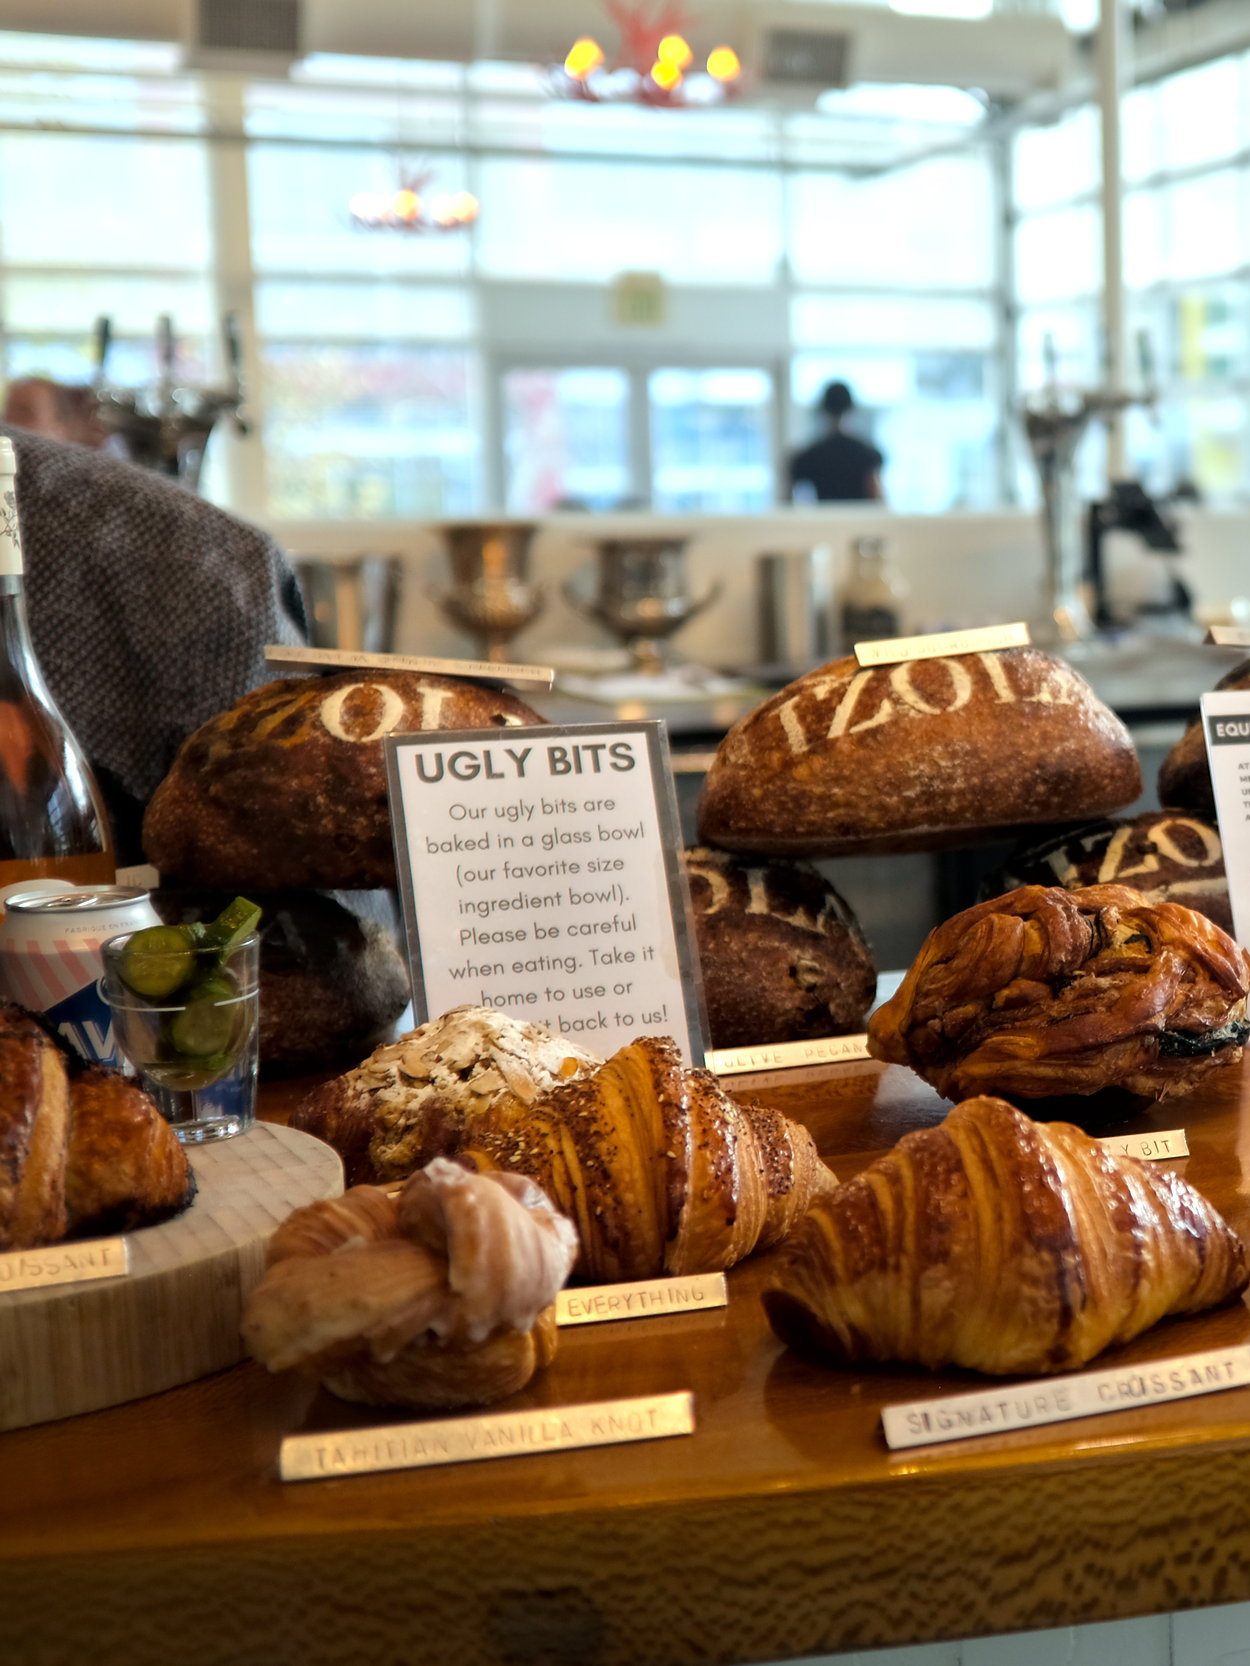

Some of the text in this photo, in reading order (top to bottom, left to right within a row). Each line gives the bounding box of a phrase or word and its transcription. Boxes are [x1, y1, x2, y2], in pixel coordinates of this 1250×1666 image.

[415, 742, 635, 783] UGLY BITS
[1238, 762, 1250, 770] AT
[449, 798, 615, 822] Our ugly bits are
[425, 822, 644, 854] baked in a glass bowl
[455, 858, 625, 887] (our favorite size
[459, 884, 630, 918] ingredient bowl).
[459, 914, 637, 946] Please be careful
[448, 945, 655, 980] when eating. Take it
[481, 980, 633, 1008] home to use or
[558, 1011, 607, 1033] back
[614, 1011, 634, 1027] to
[641, 1004, 668, 1025] us!
[1140, 1140, 1171, 1157] BIT
[567, 1286, 704, 1318] EVERYTHING
[907, 1361, 1235, 1435] SIGNATURE CROISSANT
[315, 1408, 659, 1472] TAHITIAN VANILLA KNOT
